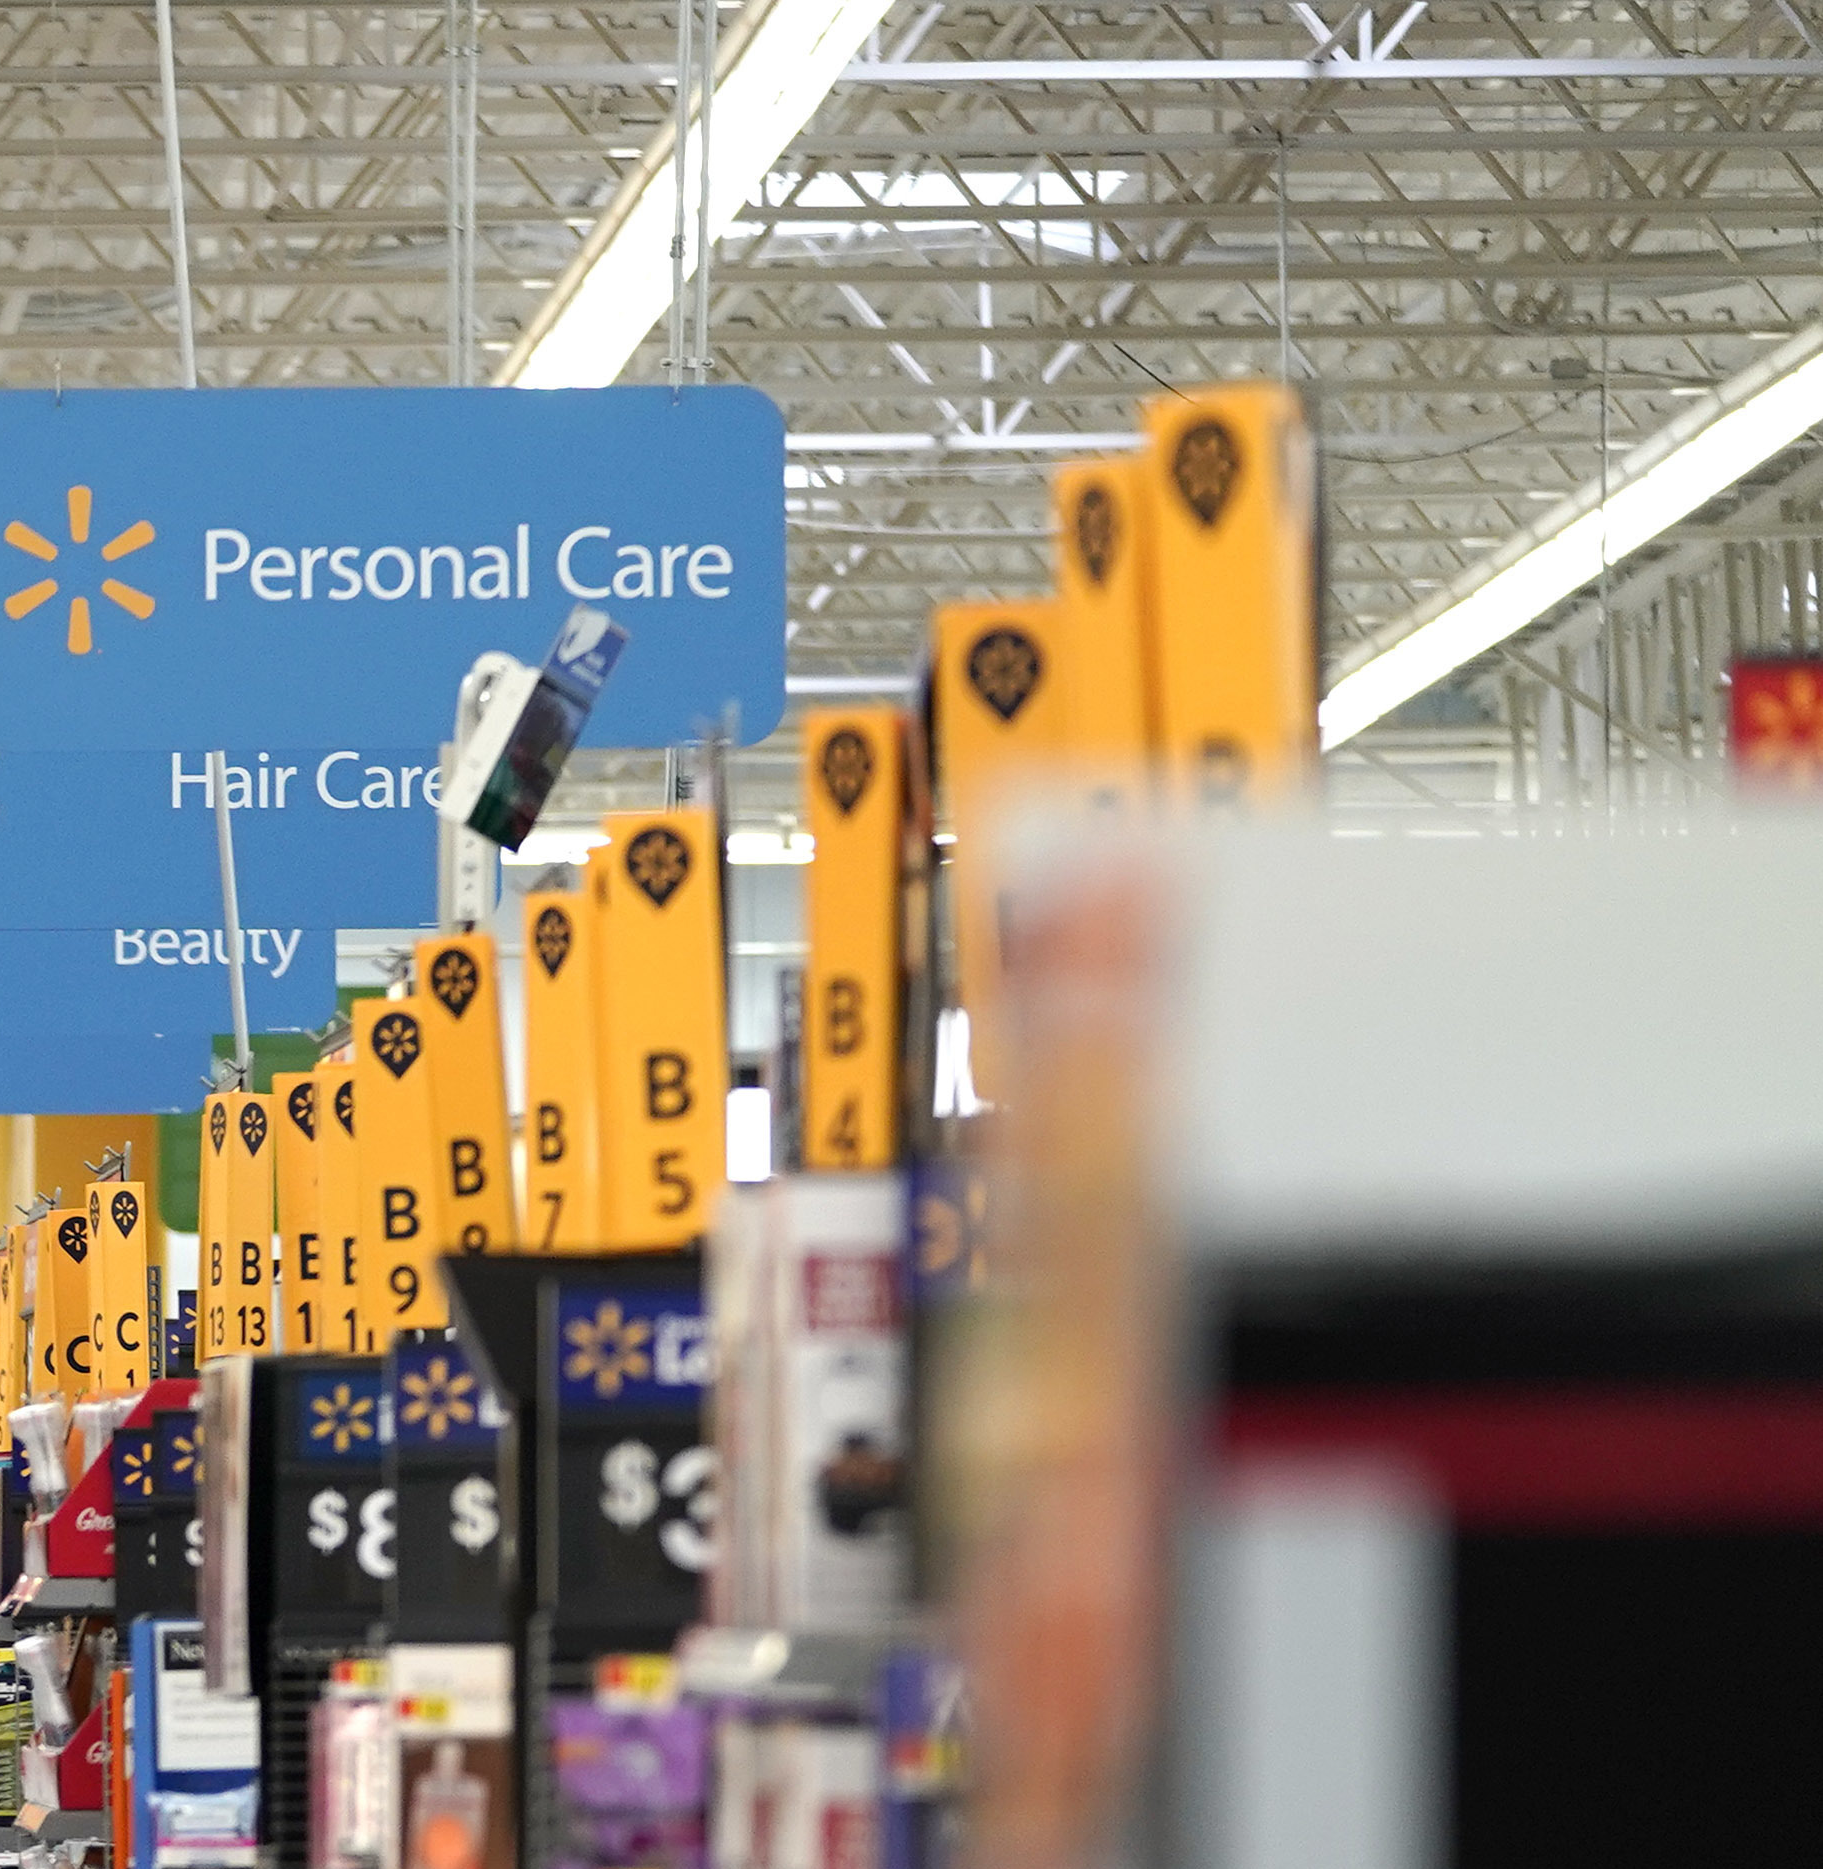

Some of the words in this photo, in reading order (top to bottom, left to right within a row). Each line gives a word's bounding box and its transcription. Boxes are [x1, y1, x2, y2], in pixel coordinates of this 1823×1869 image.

[202, 522, 531, 603] Personal
[556, 525, 734, 603] Care
[170, 750, 299, 811] Hair
[315, 750, 444, 812] Care
[113, 927, 303, 981] Beauty
[825, 977, 867, 1057] B
[646, 1052, 694, 1121] B
[537, 1103, 568, 1164] B
[451, 1138, 489, 1198] B
[651, 1150, 694, 1216] 5
[383, 1187, 419, 1241] B
[241, 1241, 261, 1286] B
[389, 1263, 420, 1315] 9
[117, 1311, 141, 1351] C
[237, 1305, 266, 1347] 13
